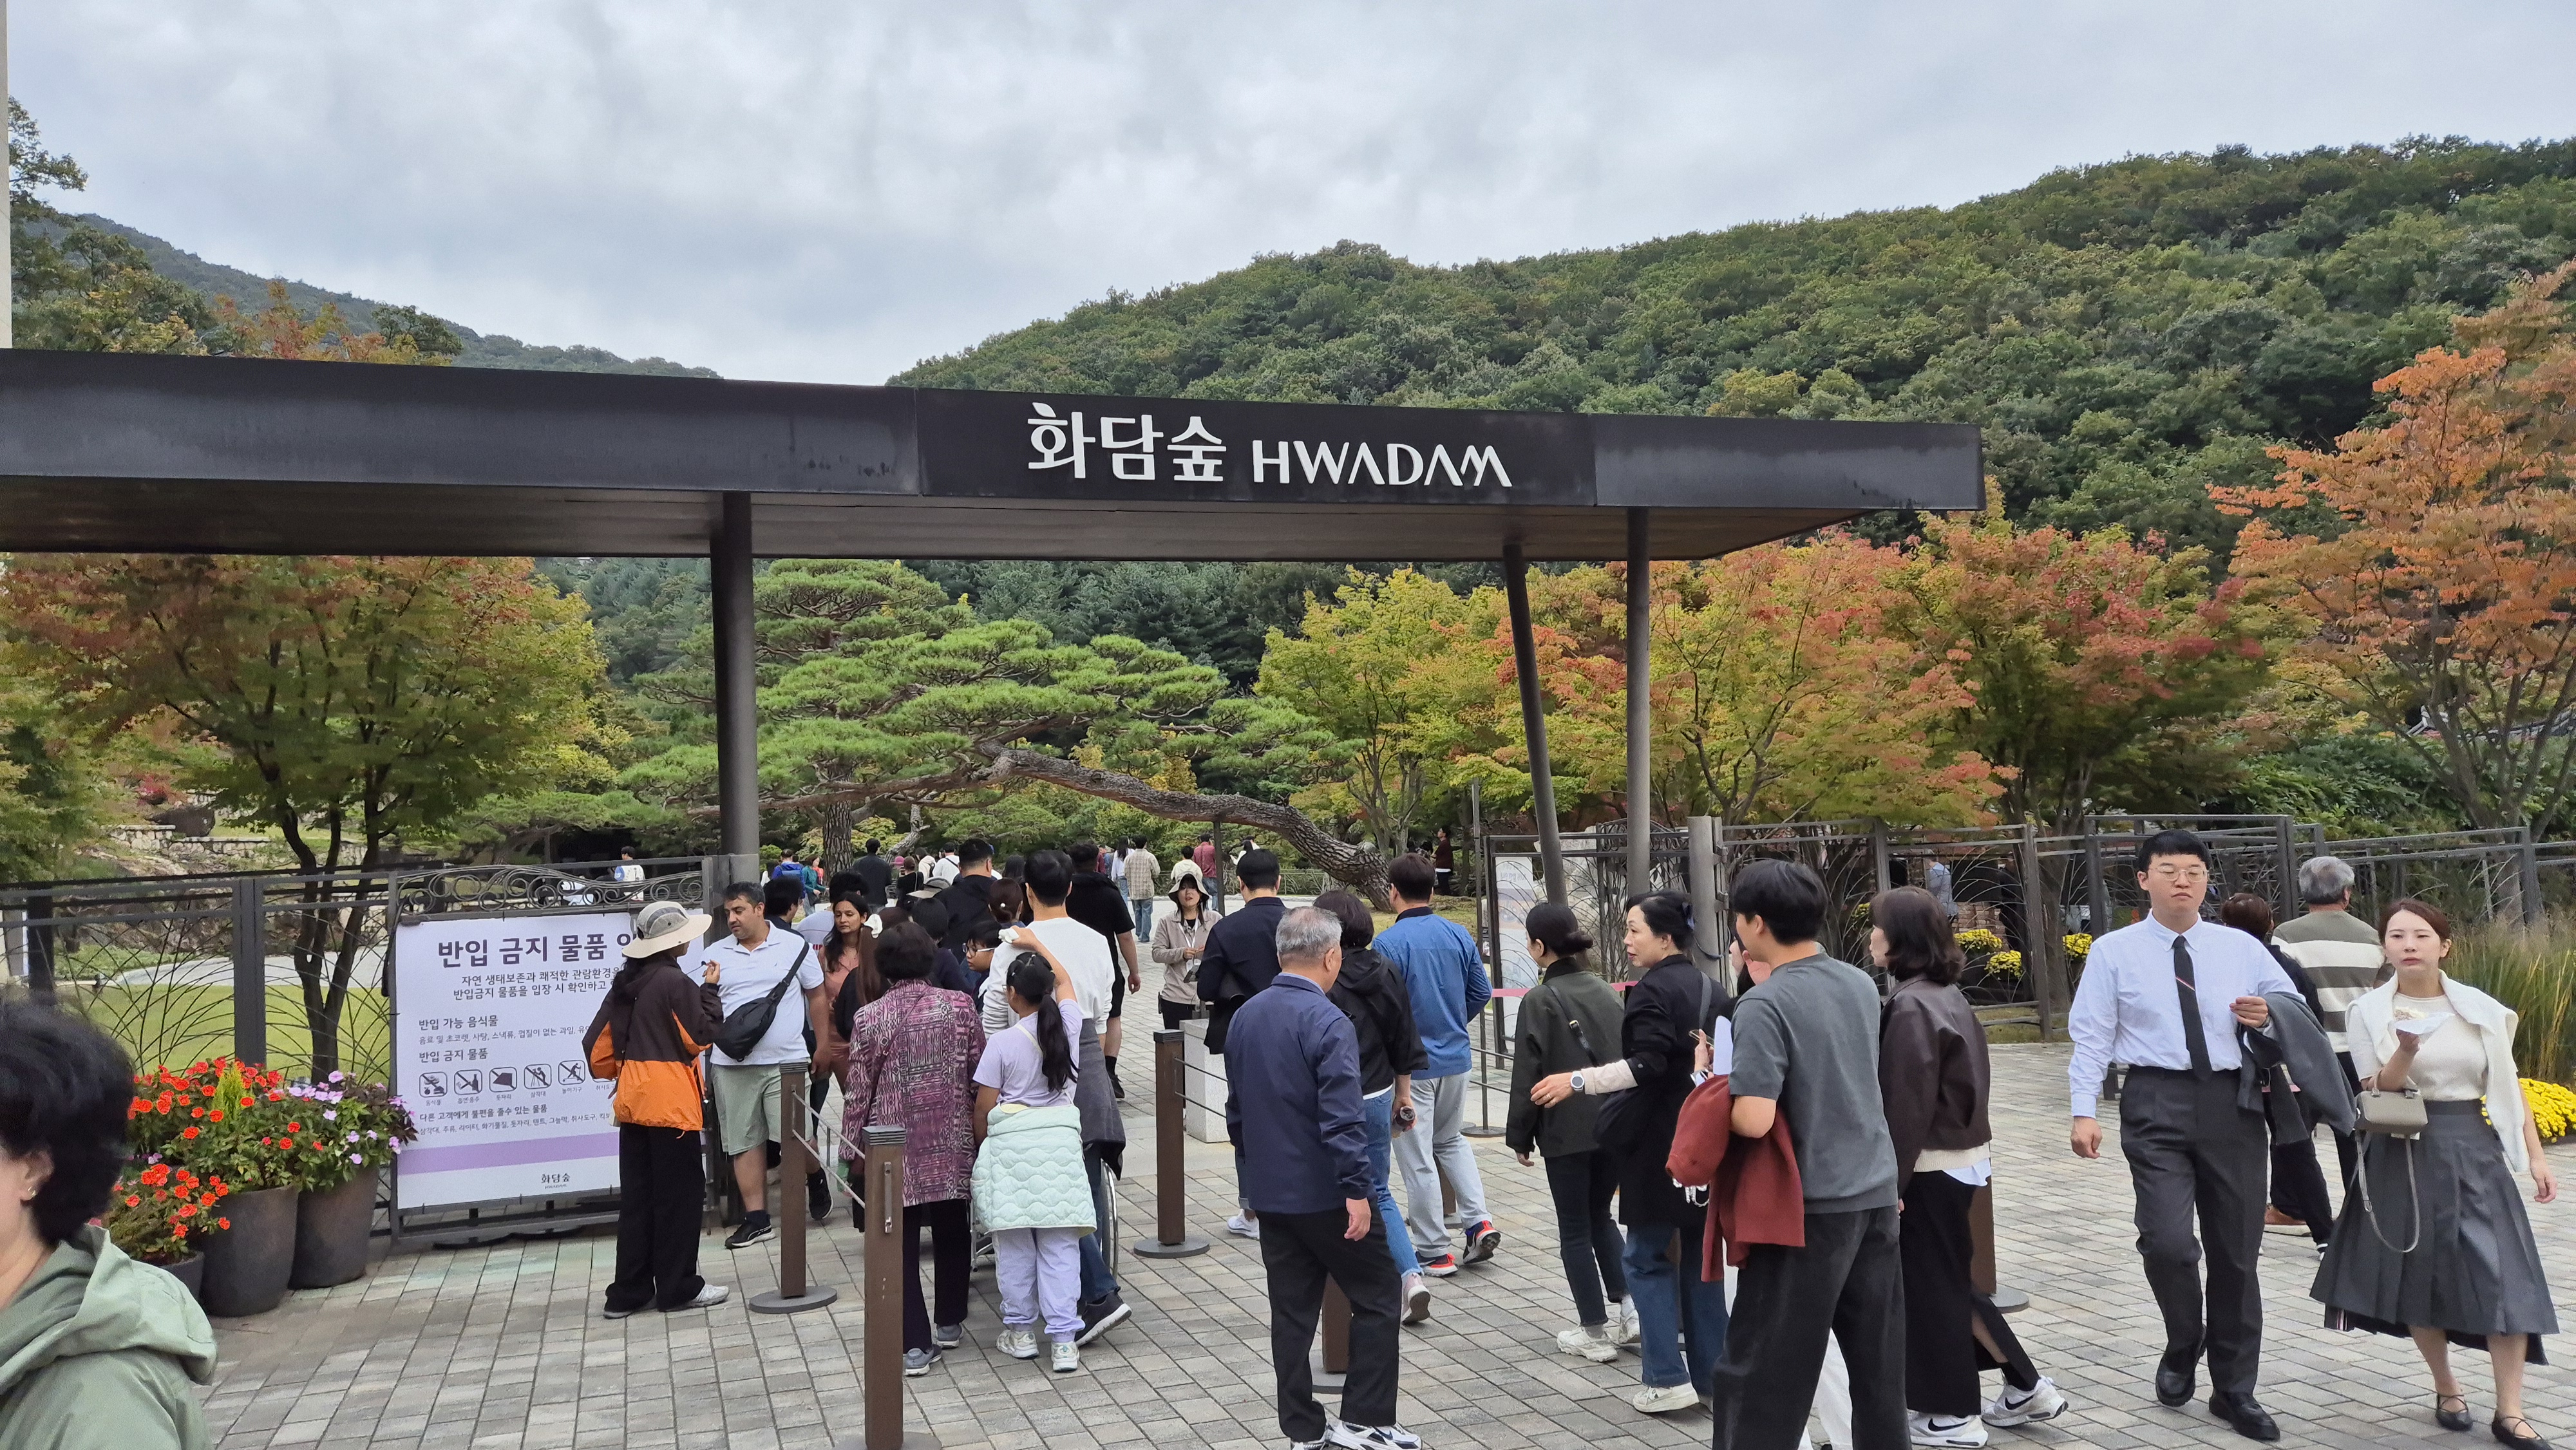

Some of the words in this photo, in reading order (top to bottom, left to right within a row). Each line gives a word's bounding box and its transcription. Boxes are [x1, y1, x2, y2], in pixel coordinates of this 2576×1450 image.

[1028, 402, 1227, 482] 화담숲
[1252, 439, 1512, 487] HWADAM
[438, 939, 488, 968] 반입
[499, 936, 547, 965] 금지
[558, 933, 607, 962] 물품
[461, 975, 482, 986] 자연
[485, 971, 536, 985] 생태보존과
[539, 969, 569, 982] 쾌적한
[453, 987, 494, 1001] 반입금지
[497, 984, 527, 998] 물품을
[531, 983, 551, 996] 입장
[554, 983, 564, 993] 시
[567, 981, 607, 993] 확인하고
[419, 1018, 439, 1031] 반입
[442, 1017, 464, 1029] 가능
[467, 1014, 498, 1028] 음식물
[419, 1036, 434, 1045] 음료
[518, 1029, 540, 1039] 껍질이
[542, 1027, 557, 1037] 없는
[419, 1051, 439, 1063] 반입
[443, 1050, 464, 1062] 금지
[467, 1048, 488, 1061] 물품
[420, 1113, 435, 1122] 다른
[437, 1111, 468, 1121] 고객에게
[515, 1105, 530, 1115] 있는
[532, 1104, 547, 1114] 물품
[541, 1172, 571, 1183] 화담숲
